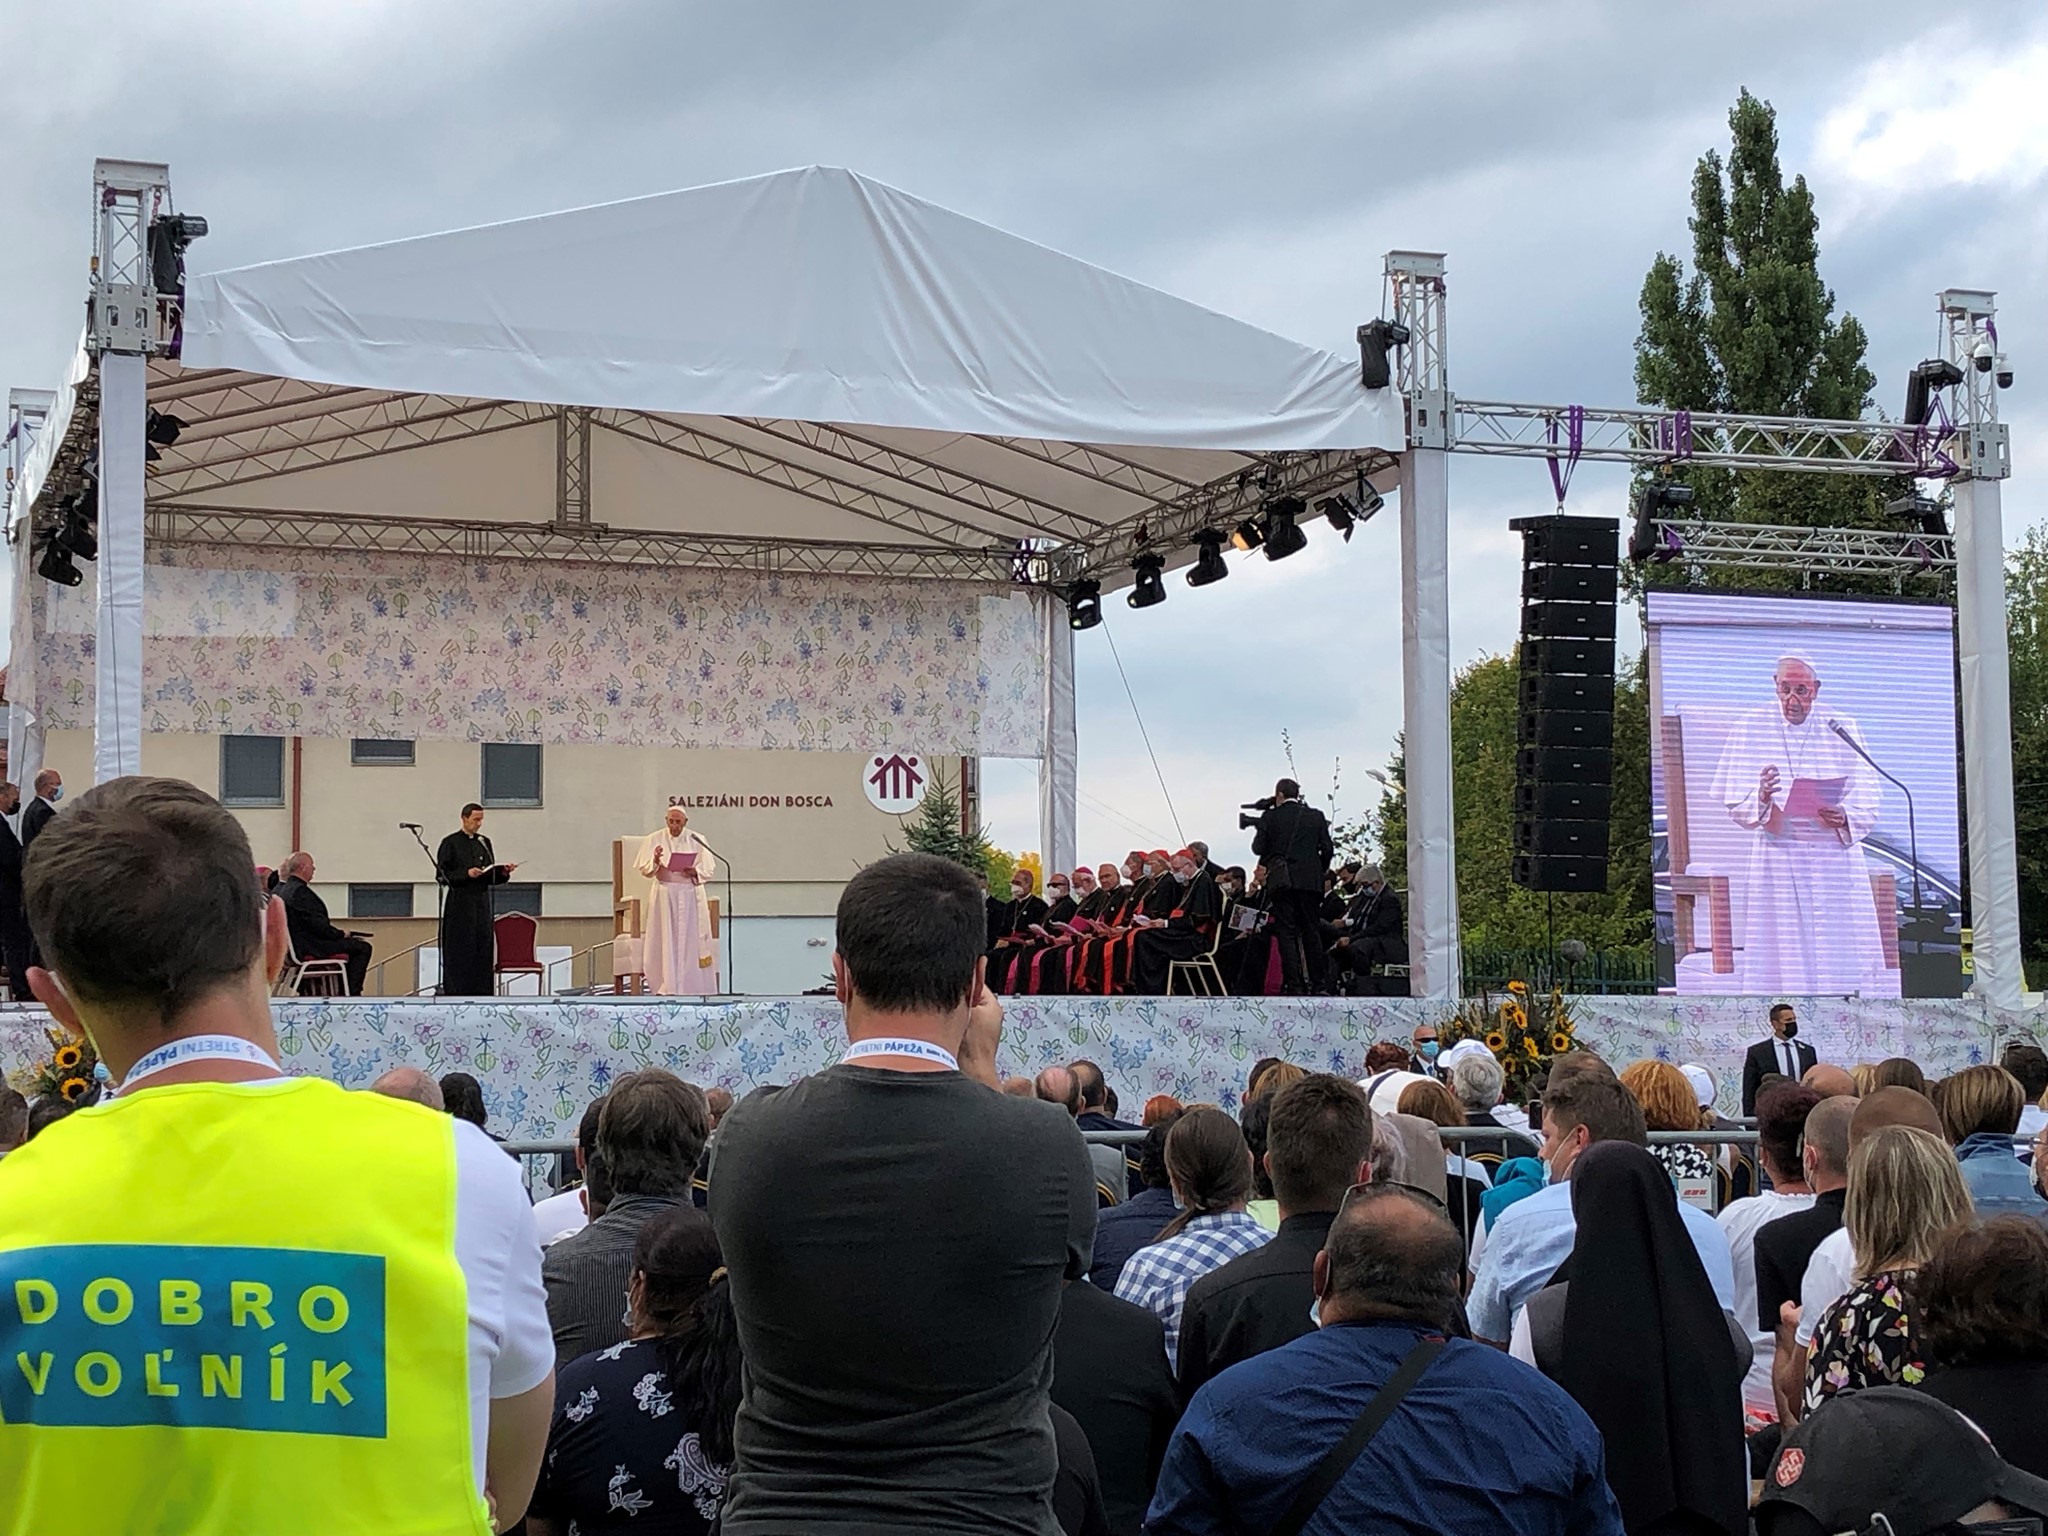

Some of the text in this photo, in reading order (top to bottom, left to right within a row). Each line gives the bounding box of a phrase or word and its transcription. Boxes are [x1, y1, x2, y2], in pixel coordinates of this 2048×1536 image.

[669, 793, 833, 807] SALEZIÁNI DON BOSCA
[884, 1042, 923, 1054] PÁPEŽA
[15, 1277, 350, 1334] DOBRO
[17, 1342, 354, 1407] VOĽNÍK
